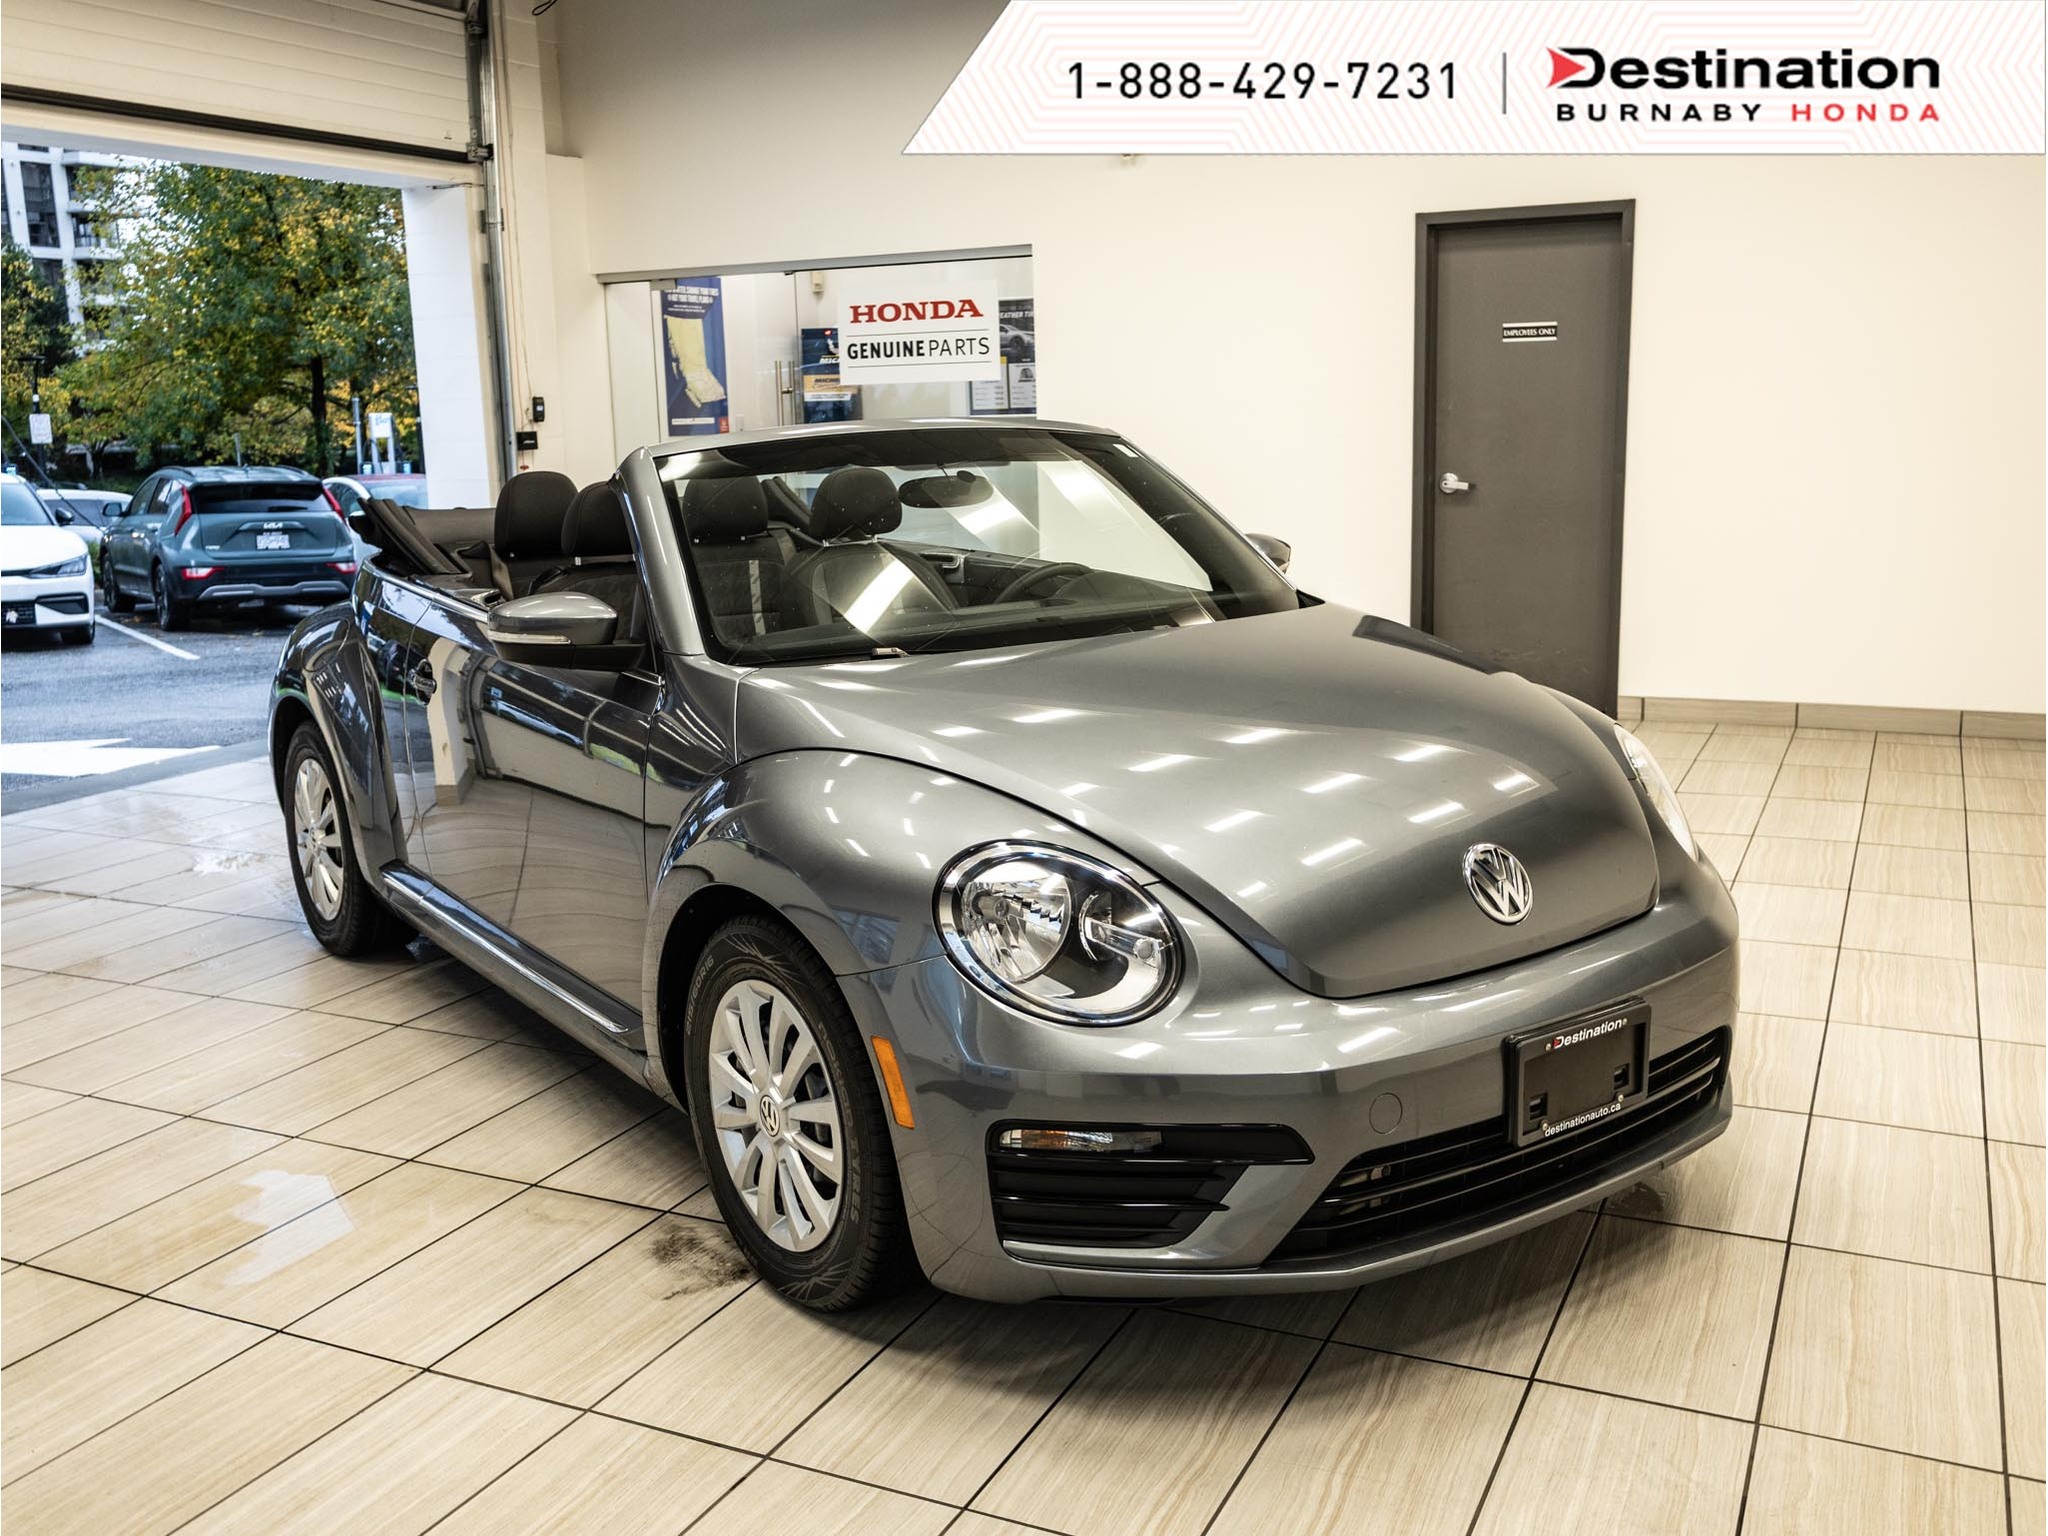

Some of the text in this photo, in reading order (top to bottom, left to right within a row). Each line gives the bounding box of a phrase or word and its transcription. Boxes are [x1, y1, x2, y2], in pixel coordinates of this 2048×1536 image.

[849, 298, 984, 325] HONDA
[1503, 328, 1556, 337] EMPLOYEES ONLY
[847, 337, 990, 360] GENUINE PARTS
[1553, 1018, 1622, 1050] Destination
[1544, 1102, 1622, 1138] destinationauto.ca
